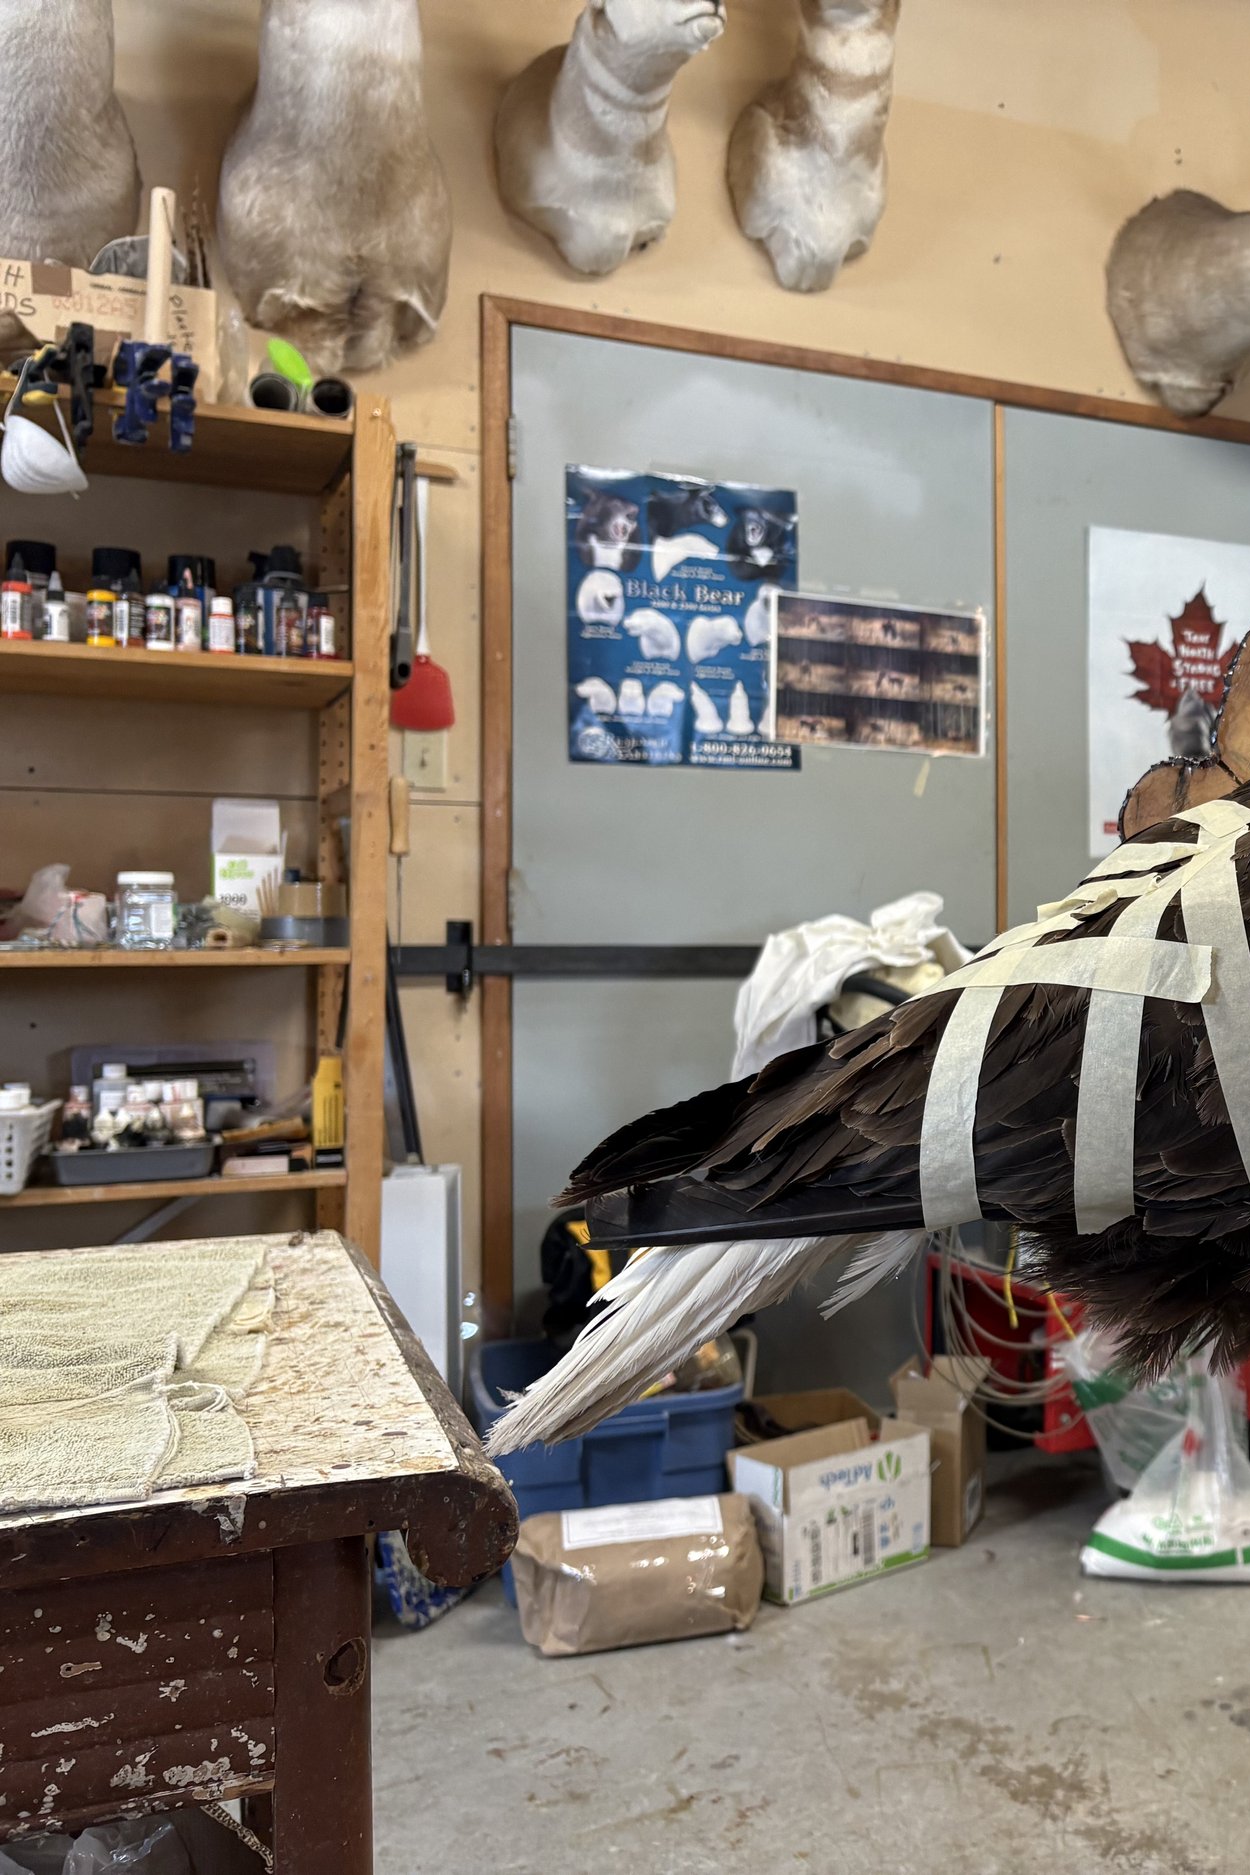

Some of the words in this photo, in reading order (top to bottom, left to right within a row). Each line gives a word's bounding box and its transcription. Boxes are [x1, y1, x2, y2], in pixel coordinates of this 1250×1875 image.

[626, 578, 687, 600] Black
[695, 584, 745, 606] Bear
[820, 1463, 873, 1490] AdTech
